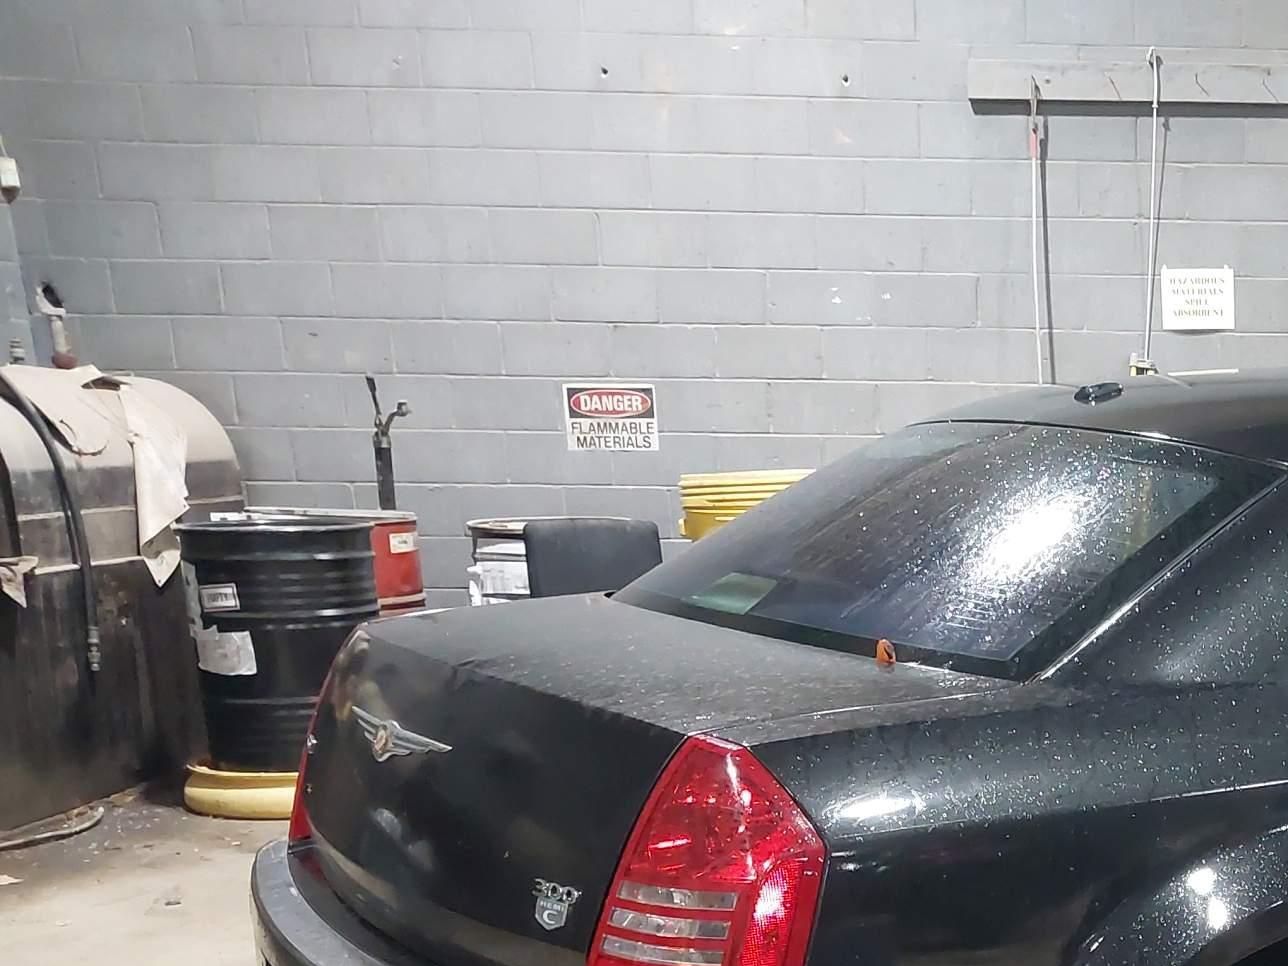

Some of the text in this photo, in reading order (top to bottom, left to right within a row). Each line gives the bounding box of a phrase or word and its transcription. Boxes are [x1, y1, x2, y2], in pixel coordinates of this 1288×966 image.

[1169, 277, 1225, 285] HAZARDOUS
[1172, 288, 1224, 296] MATERIALS
[579, 394, 643, 412] DANGER
[571, 421, 655, 435] FLAMMABLE
[576, 435, 652, 449] MATERIALS
[531, 878, 578, 905] 300
